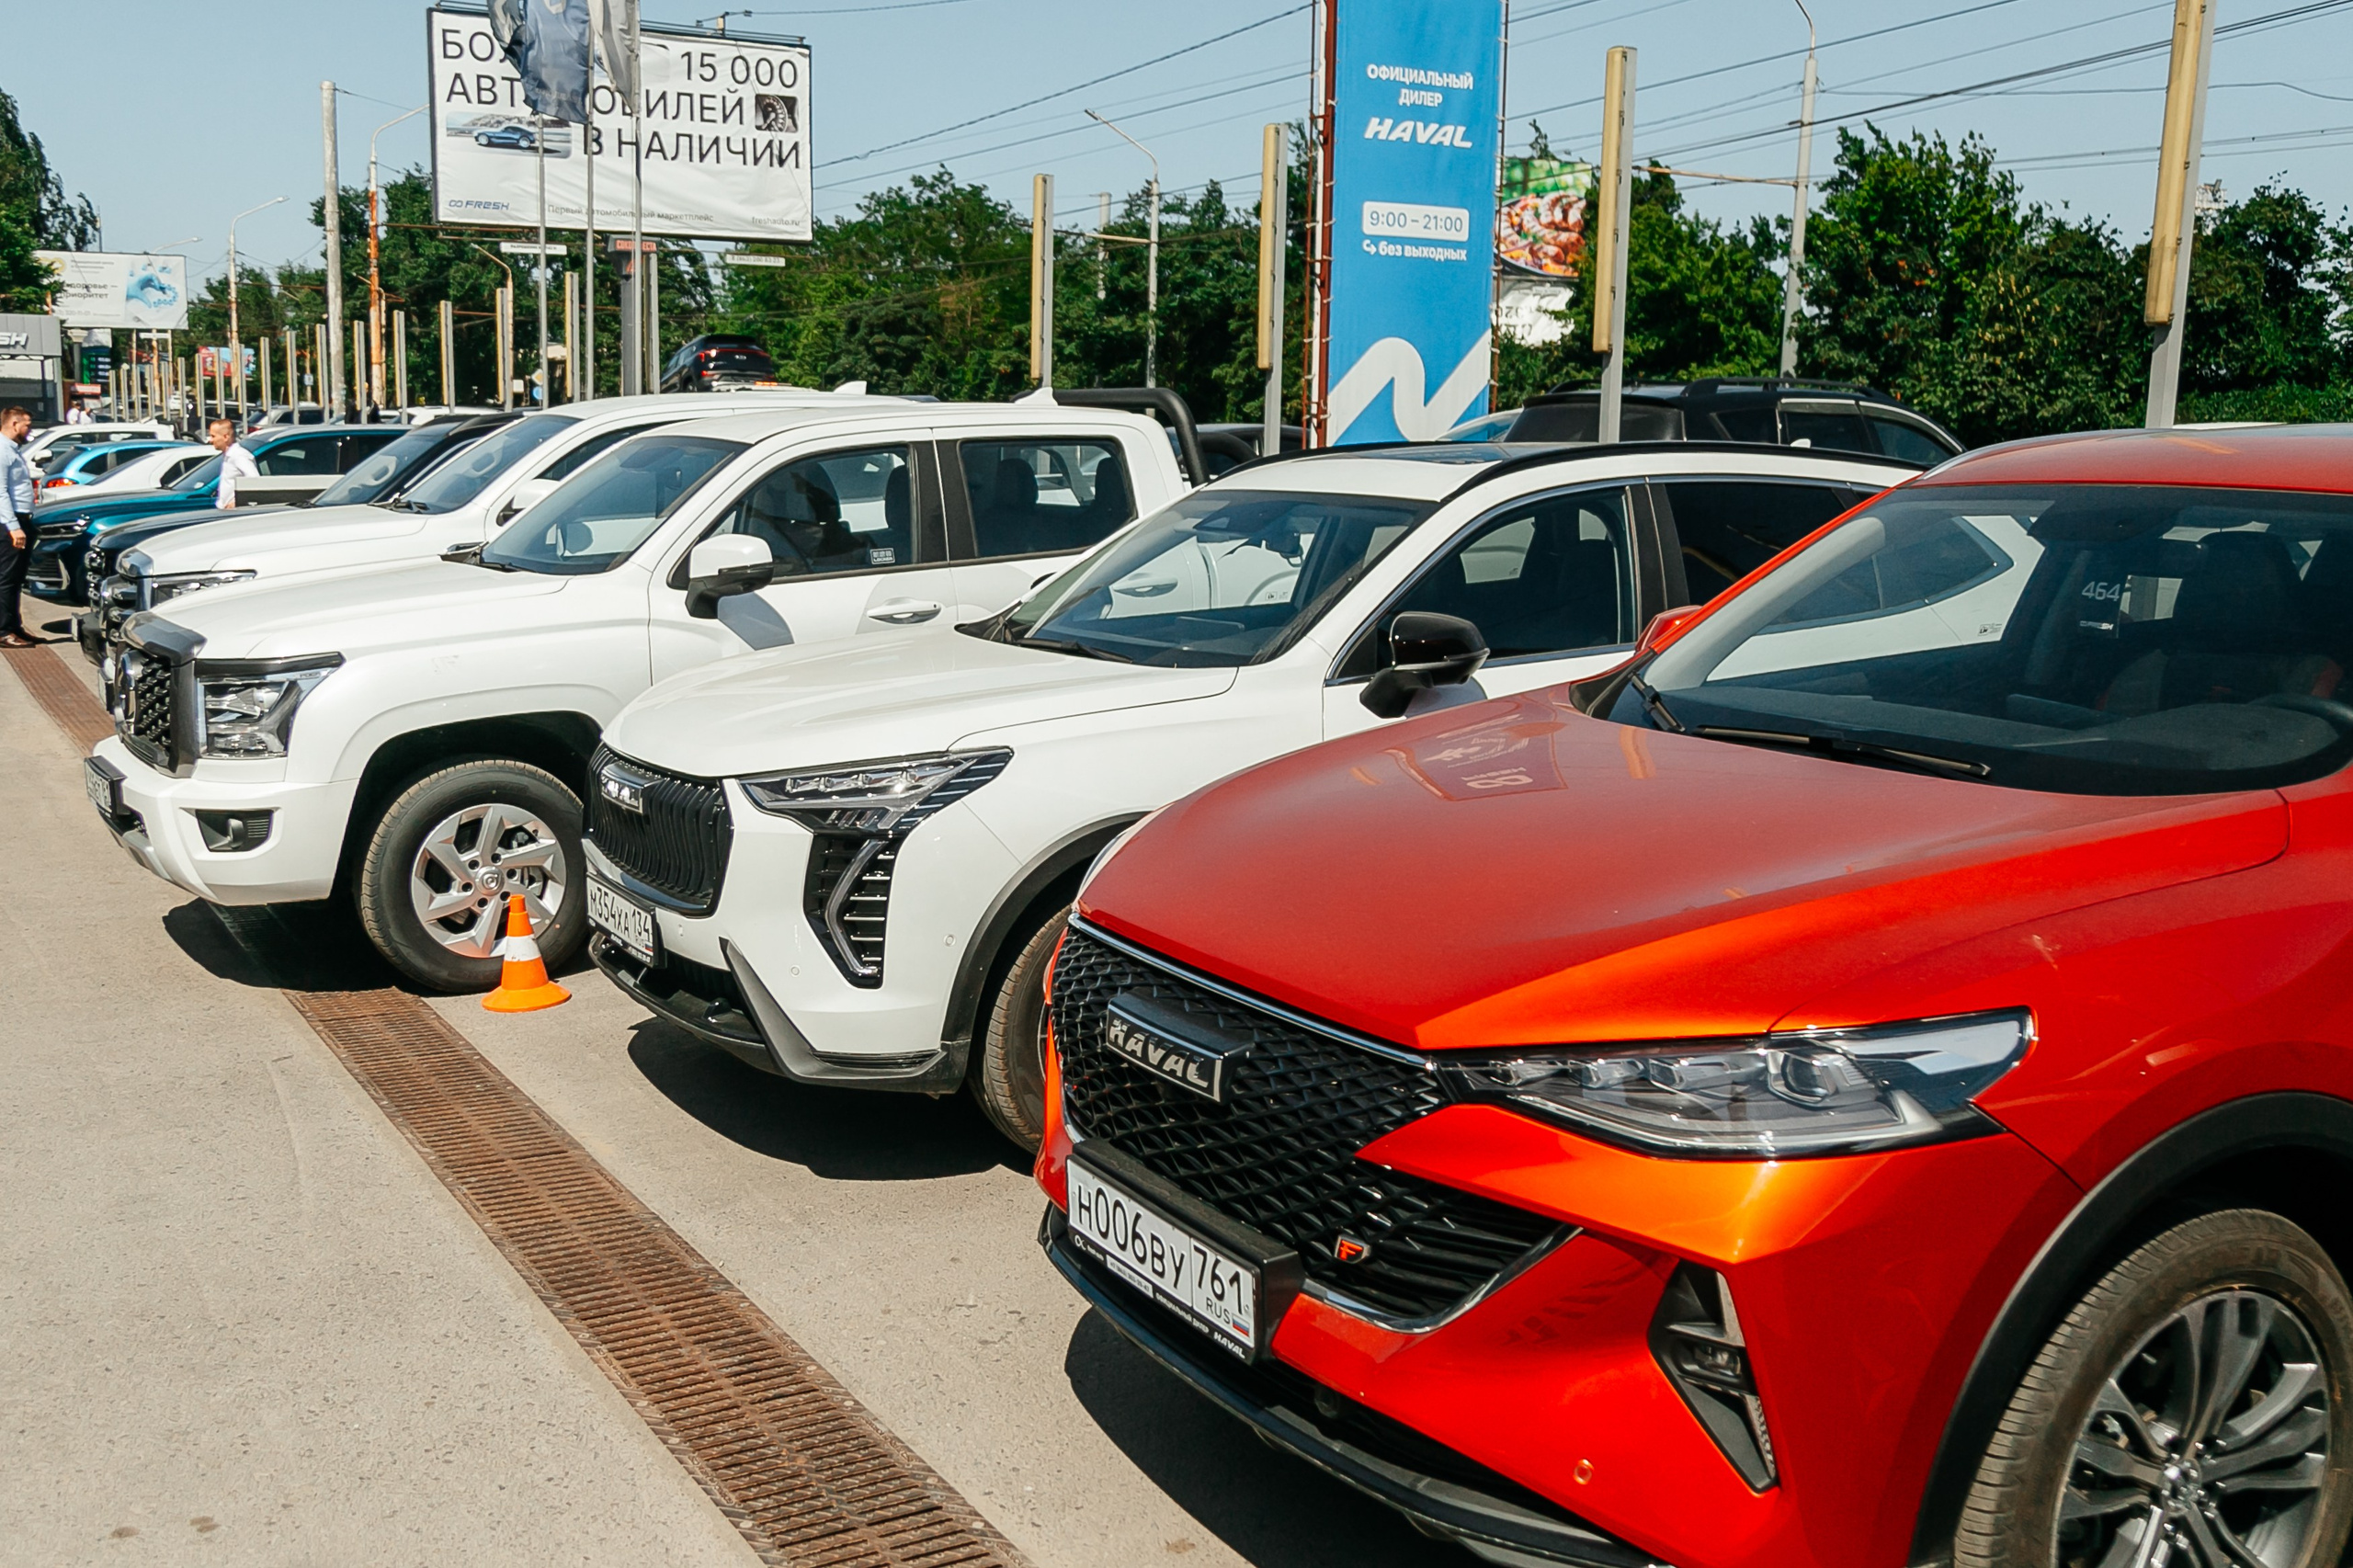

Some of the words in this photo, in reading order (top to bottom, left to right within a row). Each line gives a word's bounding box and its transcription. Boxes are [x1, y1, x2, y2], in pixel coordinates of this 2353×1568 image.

[681, 51, 717, 82] 15
[731, 55, 798, 88] 000
[1367, 63, 1474, 90] ОФИЦИАЛЬНЫЙ
[1398, 88, 1443, 107] ДИЛЕР
[1365, 117, 1473, 149] HAVAL
[618, 129, 801, 169] НАЛИЧИИ
[548, 205, 583, 215] Первый
[657, 213, 714, 223] маркетплейс
[752, 216, 801, 227] freshauto.ru
[1370, 210, 1407, 228] 9:00
[1423, 214, 1463, 233] 21:00
[1379, 241, 1403, 256] без
[1404, 244, 1468, 262] выходных
[2081, 581, 2121, 602] 464
[590, 886, 631, 938] М354ХА
[631, 908, 651, 942] 134
[1108, 1017, 1210, 1088] HAVAL
[1078, 1184, 1185, 1290] Н006ВУ
[1193, 1244, 1243, 1315] 761
[1206, 1297, 1231, 1324] RUS
[1213, 1331, 1246, 1359] HAVAL
